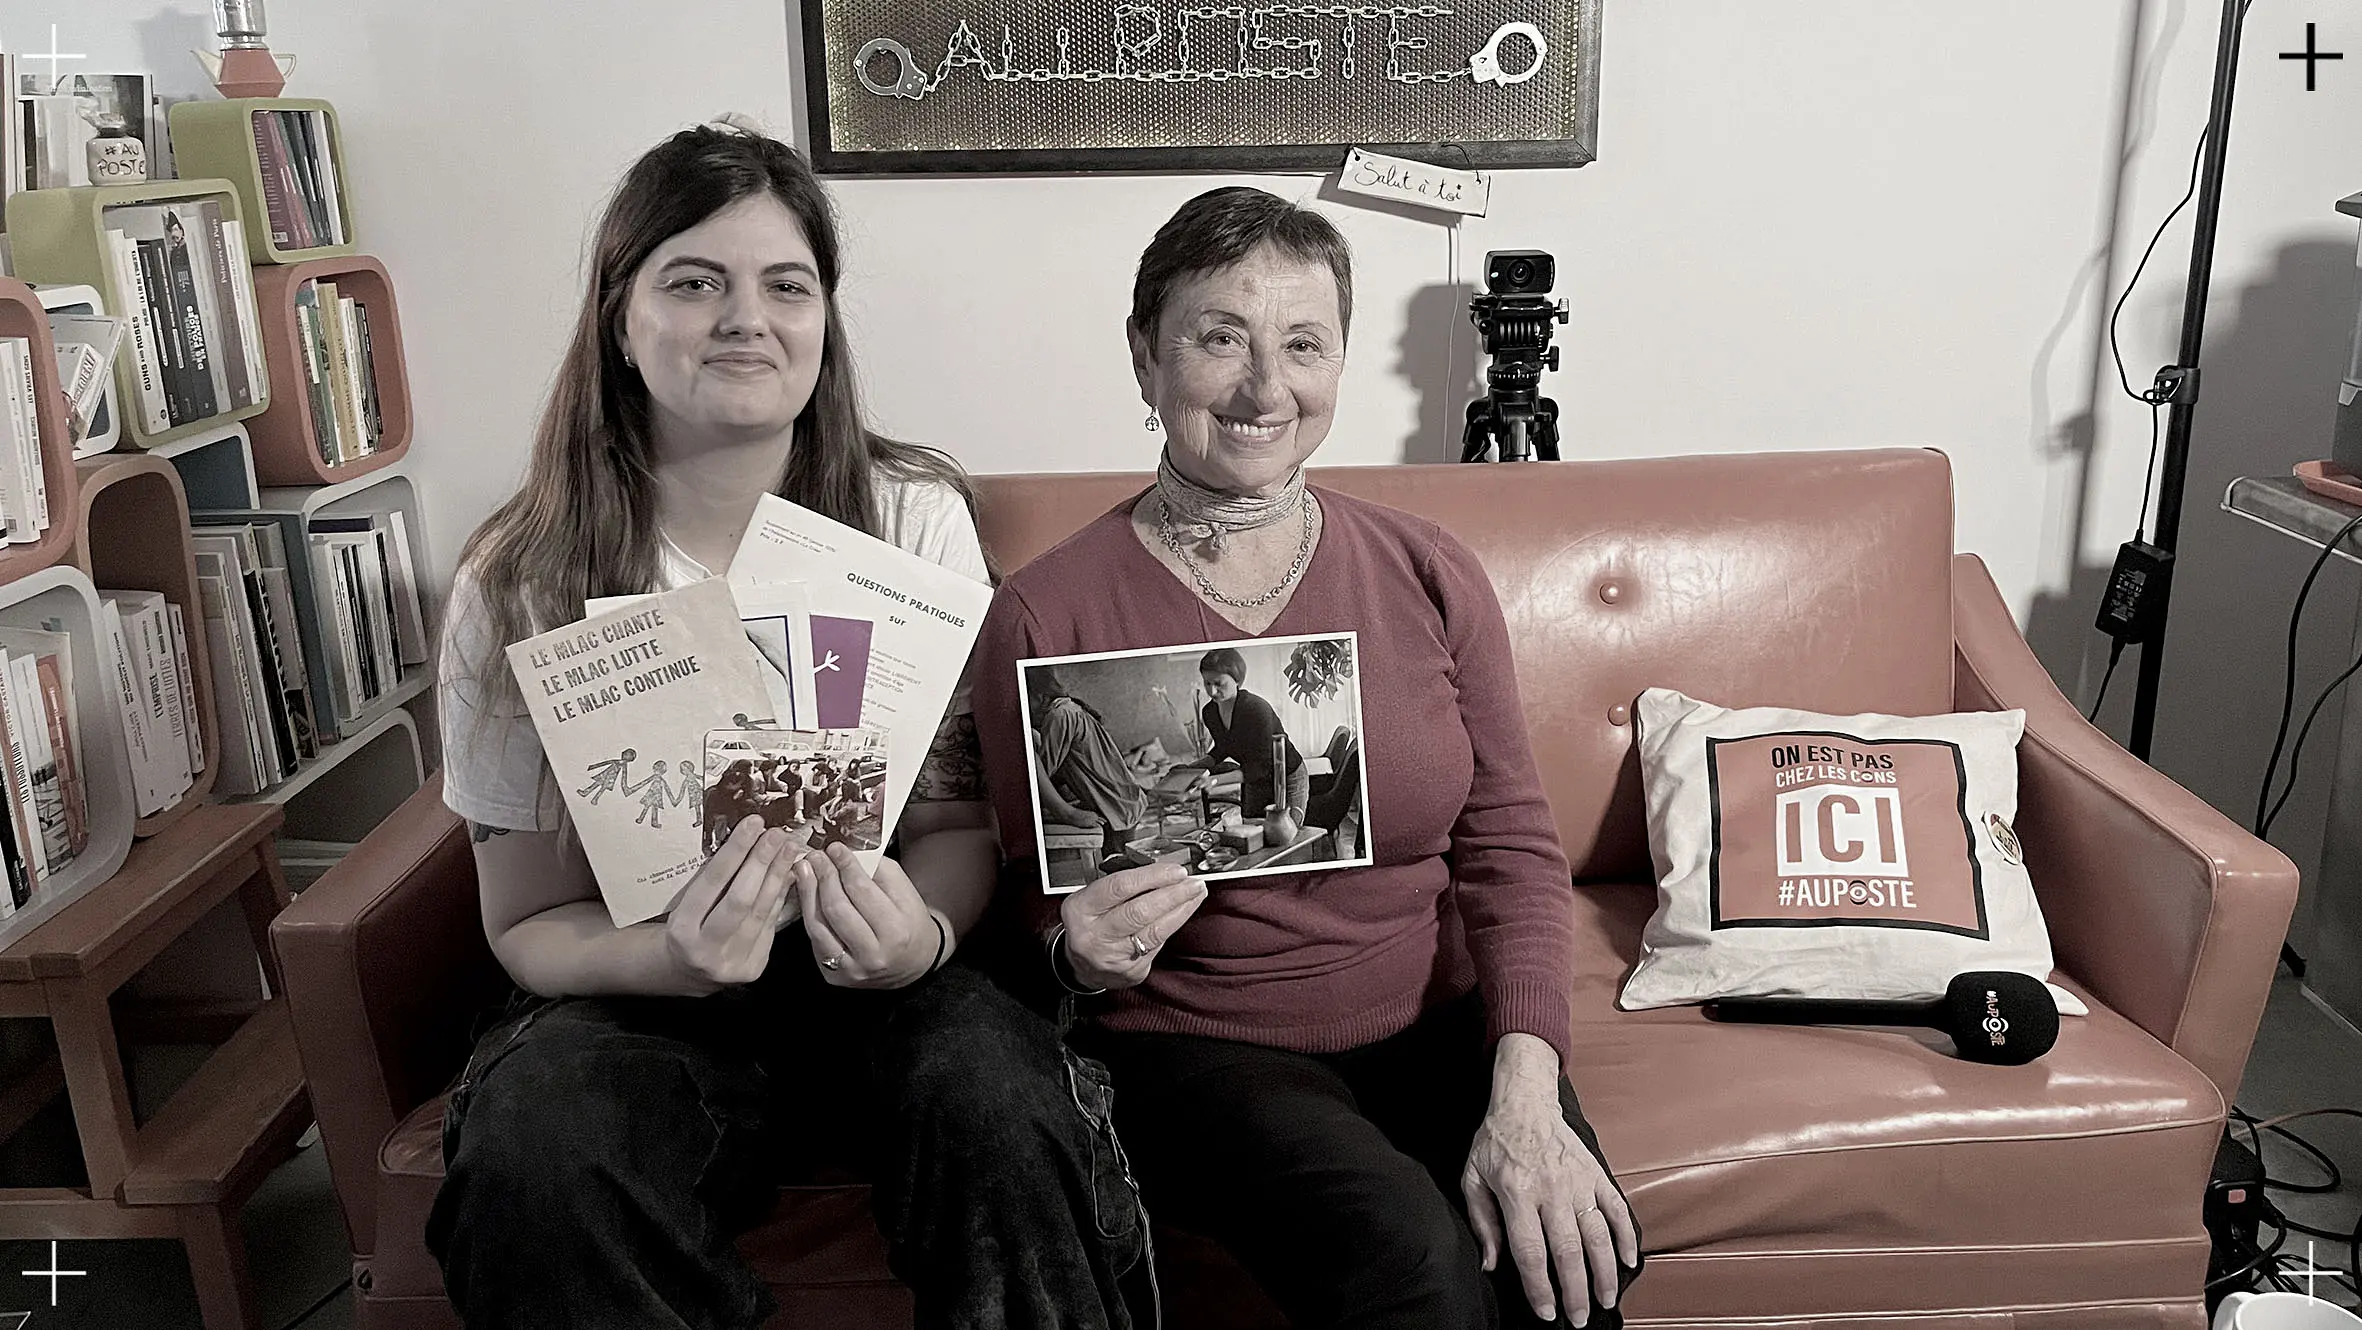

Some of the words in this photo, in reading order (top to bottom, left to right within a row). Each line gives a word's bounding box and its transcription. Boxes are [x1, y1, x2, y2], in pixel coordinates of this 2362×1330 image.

[97, 158, 145, 176] POSTE
[1355, 162, 1413, 190] Salut
[1418, 179, 1430, 194] à
[1435, 178, 1462, 201] toi
[211, 218, 219, 237] Paris
[132, 316, 143, 348] ROSES
[186, 304, 199, 348] POLICES
[193, 313, 203, 346] FRANCE
[141, 363, 151, 390] GUNS
[845, 571, 906, 604] QUESTIONS
[908, 598, 965, 628] PRATIQUES
[888, 614, 906, 627] sur
[530, 648, 551, 668] LE
[553, 630, 599, 660] MLAC
[601, 608, 664, 643] CHANTE
[159, 657, 175, 688] LUTTES
[541, 674, 563, 696] LE
[564, 657, 610, 687] MLAC
[610, 639, 662, 670] LUTTE
[0, 671, 8, 707] CASTANE
[148, 672, 164, 718] L'EMPRISE
[164, 688, 177, 702] DE
[553, 701, 576, 722] LE
[577, 684, 621, 714] MLAC
[622, 655, 700, 696] CONTINUE
[5, 708, 14, 736] VICTOR
[167, 705, 183, 738] TERRES
[1771, 745, 1800, 768] ON
[1808, 745, 1845, 764] EST
[1851, 752, 1894, 768] PAS
[1776, 766, 1814, 787] CHEZ
[1818, 765, 1846, 780] LES
[1851, 770, 1896, 784] CONS
[1785, 794, 1897, 863] ICI
[1778, 879, 1917, 908] #AUPOSTE
[1982, 990, 2009, 1046] #AUPOSTE
